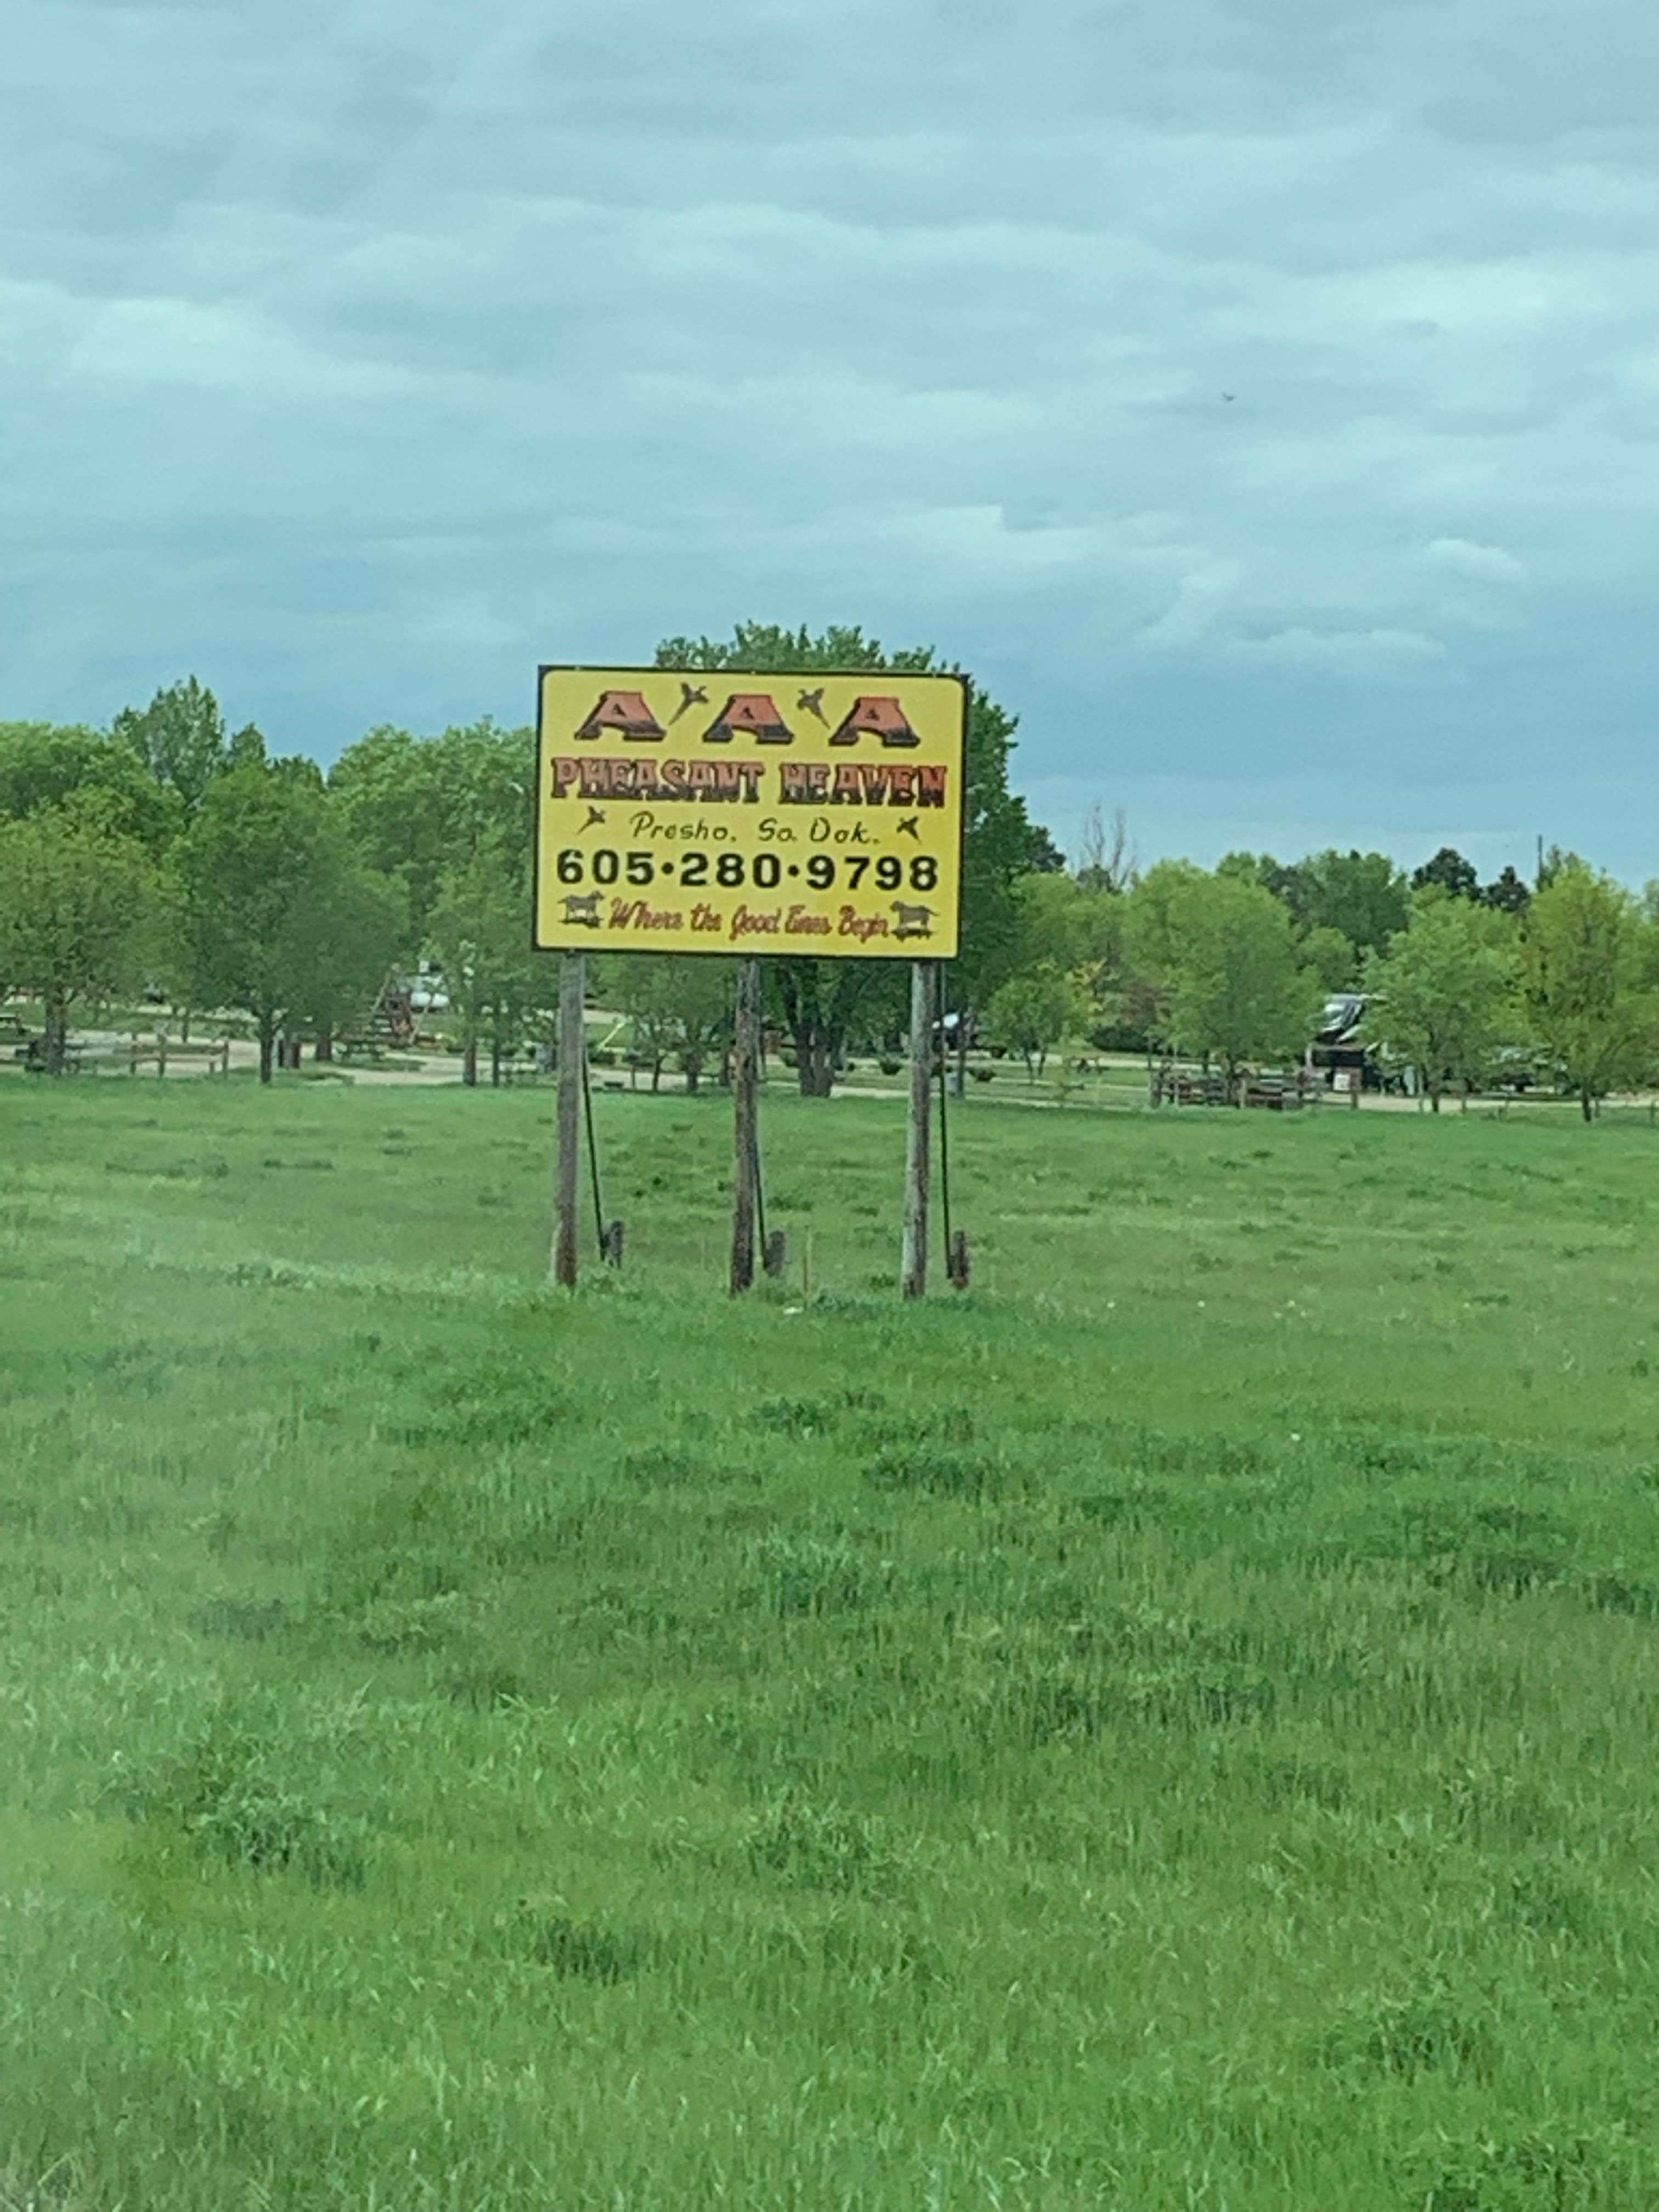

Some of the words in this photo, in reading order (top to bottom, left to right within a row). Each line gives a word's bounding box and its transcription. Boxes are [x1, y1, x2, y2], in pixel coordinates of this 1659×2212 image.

[574, 690, 667, 742] A
[702, 694, 795, 744] A
[828, 697, 921, 747] A
[551, 757, 765, 803] PHEASANT
[778, 763, 947, 808] HEAVEN
[608, 896, 684, 930] Where
[690, 902, 722, 931] the
[729, 904, 781, 941] Good
